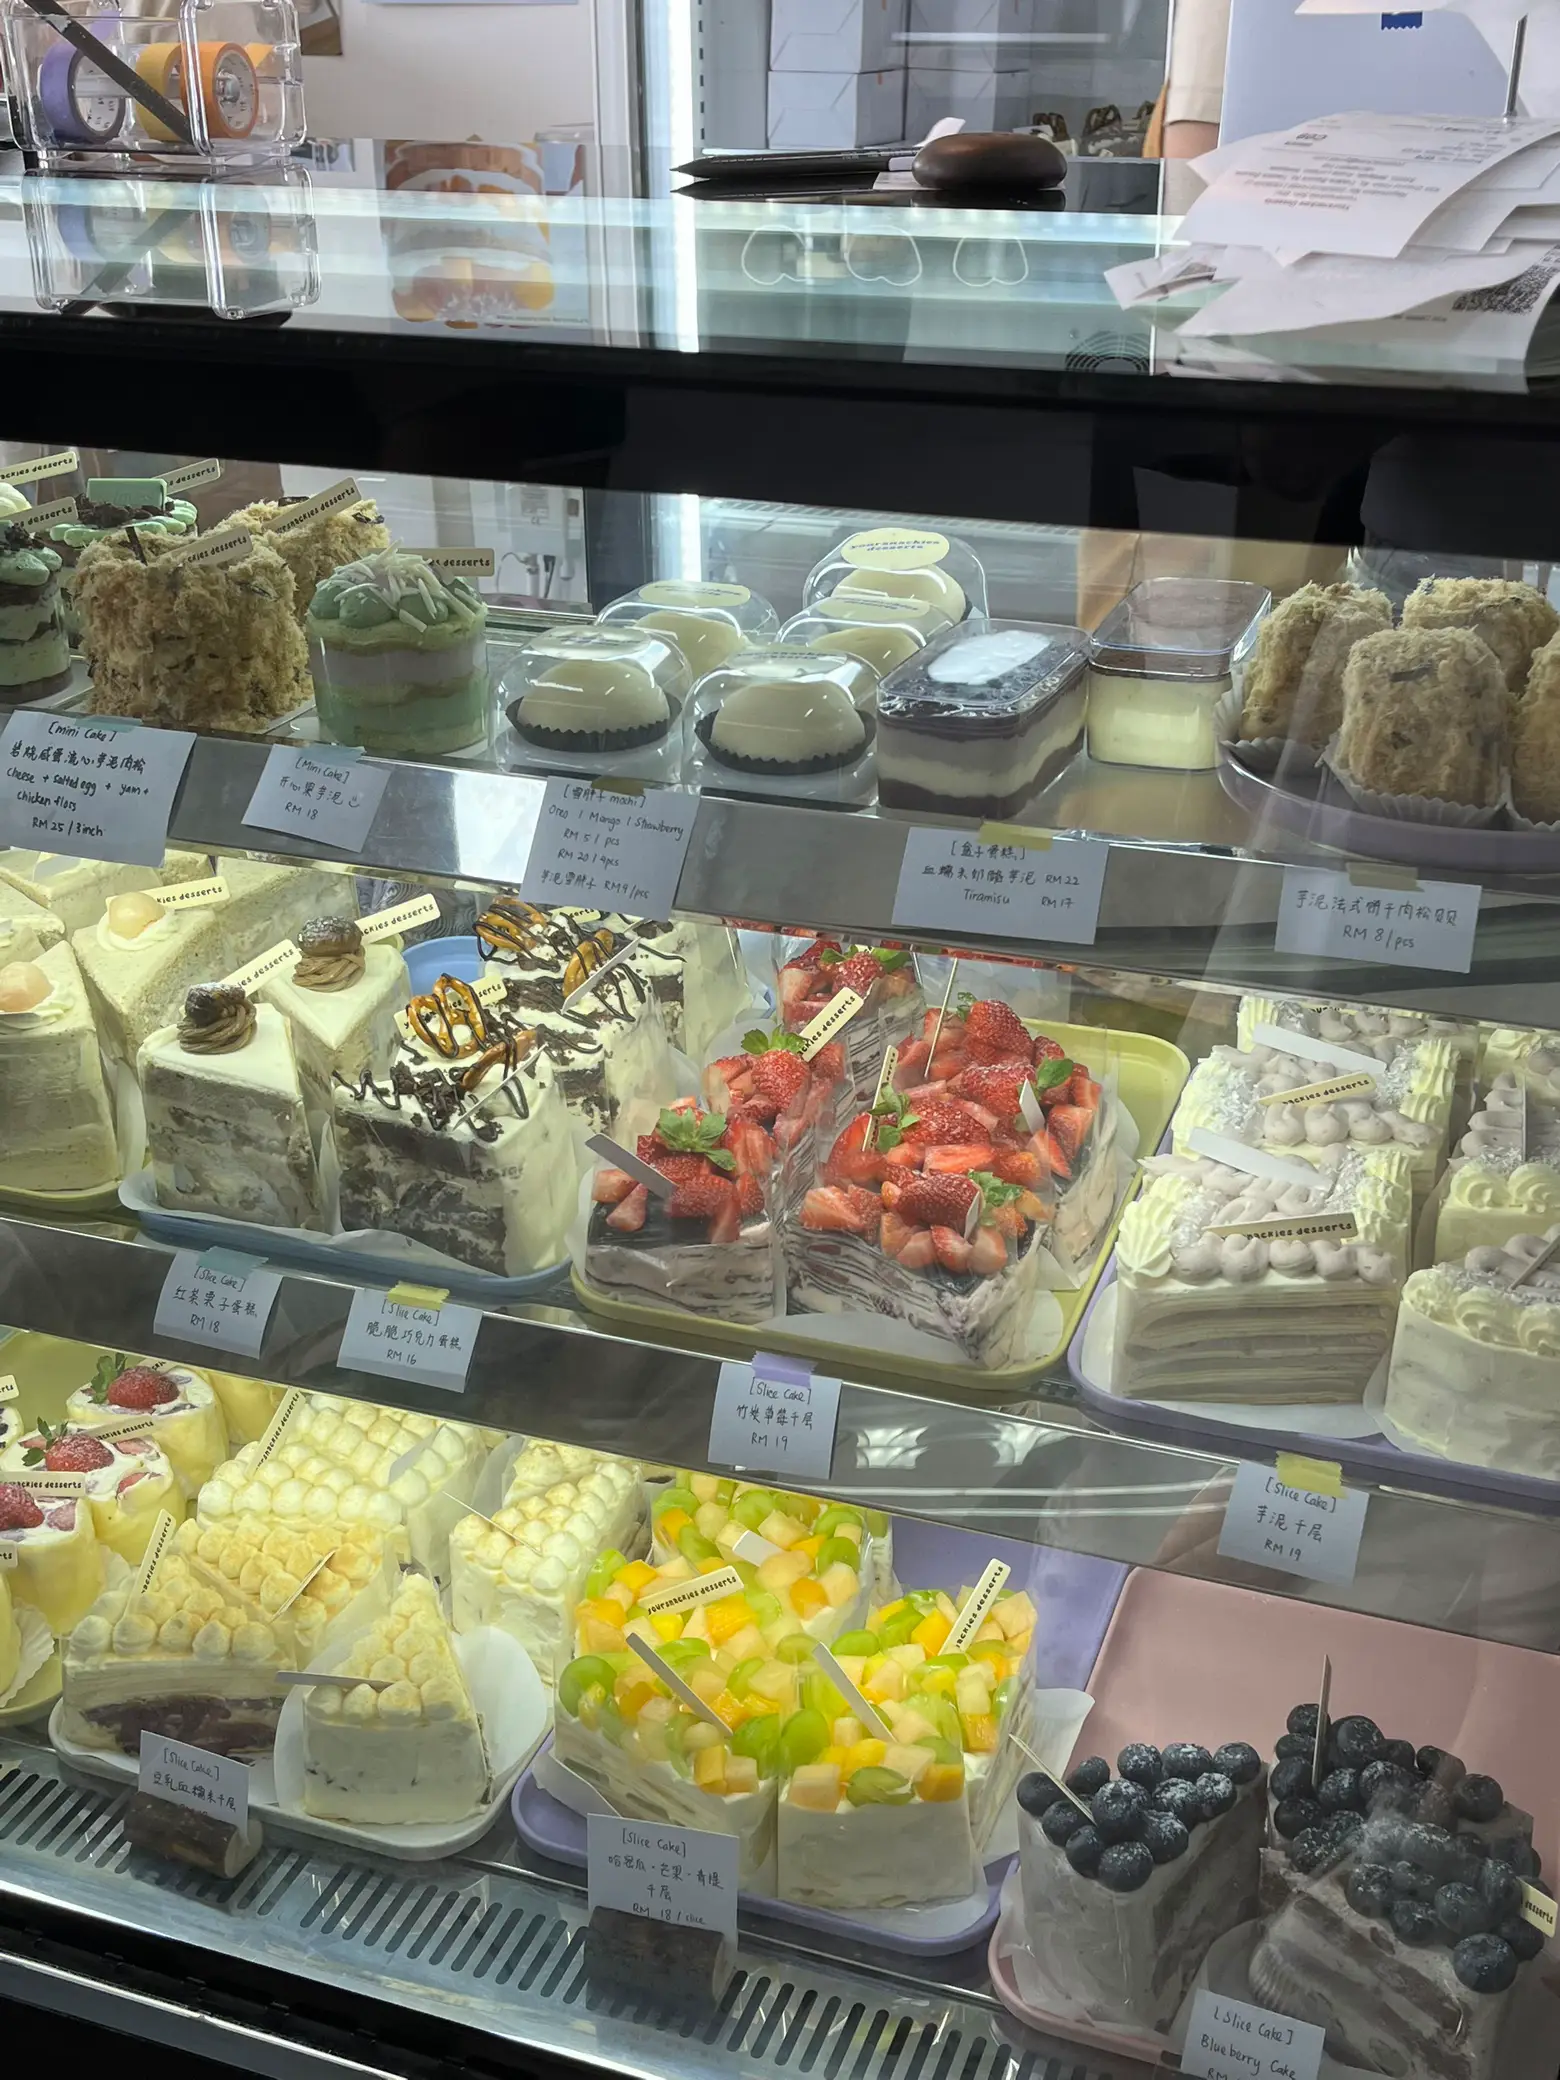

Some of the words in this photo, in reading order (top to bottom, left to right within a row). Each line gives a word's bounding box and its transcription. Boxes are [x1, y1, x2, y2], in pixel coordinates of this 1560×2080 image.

[32, 457, 73, 472] desserts
[175, 466, 216, 484] desserts
[320, 487, 355, 511] desserts
[27, 506, 73, 526] desserts
[211, 536, 248, 555] desserts
[119, 783, 141, 796] yam
[285, 802, 302, 816] RM
[306, 808, 319, 820] 18
[51, 822, 65, 832] 25
[563, 828, 579, 841] RM
[589, 812, 621, 832] Mango
[634, 817, 684, 842] Strawberry
[558, 848, 574, 861] RM
[179, 886, 223, 901] desserts
[964, 888, 1010, 904] Tiramisu
[391, 903, 434, 925] desserts
[1343, 924, 1367, 940] RM
[254, 948, 294, 979] desserts
[478, 984, 502, 998] serts
[822, 995, 856, 1032] desserts
[1323, 1078, 1370, 1097] desserts
[1295, 1221, 1352, 1236] desserts
[209, 1321, 220, 1333] 18
[387, 1349, 402, 1362] RM
[407, 1354, 417, 1365] 16
[280, 1392, 299, 1427] desserts
[122, 1420, 154, 1434] desserts
[752, 1432, 768, 1447] RM
[776, 1435, 788, 1451] 19
[44, 1481, 82, 1489] desserts
[155, 1516, 172, 1559] desserts
[1264, 1537, 1283, 1555] RM
[1289, 1548, 1301, 1561] 19
[700, 1576, 737, 1595] desserts
[976, 1566, 1003, 1611] desserts
[661, 1909, 672, 1921] 18
[1201, 2033, 1261, 2076] Blueberry
[1270, 2059, 1296, 2080] Cake
